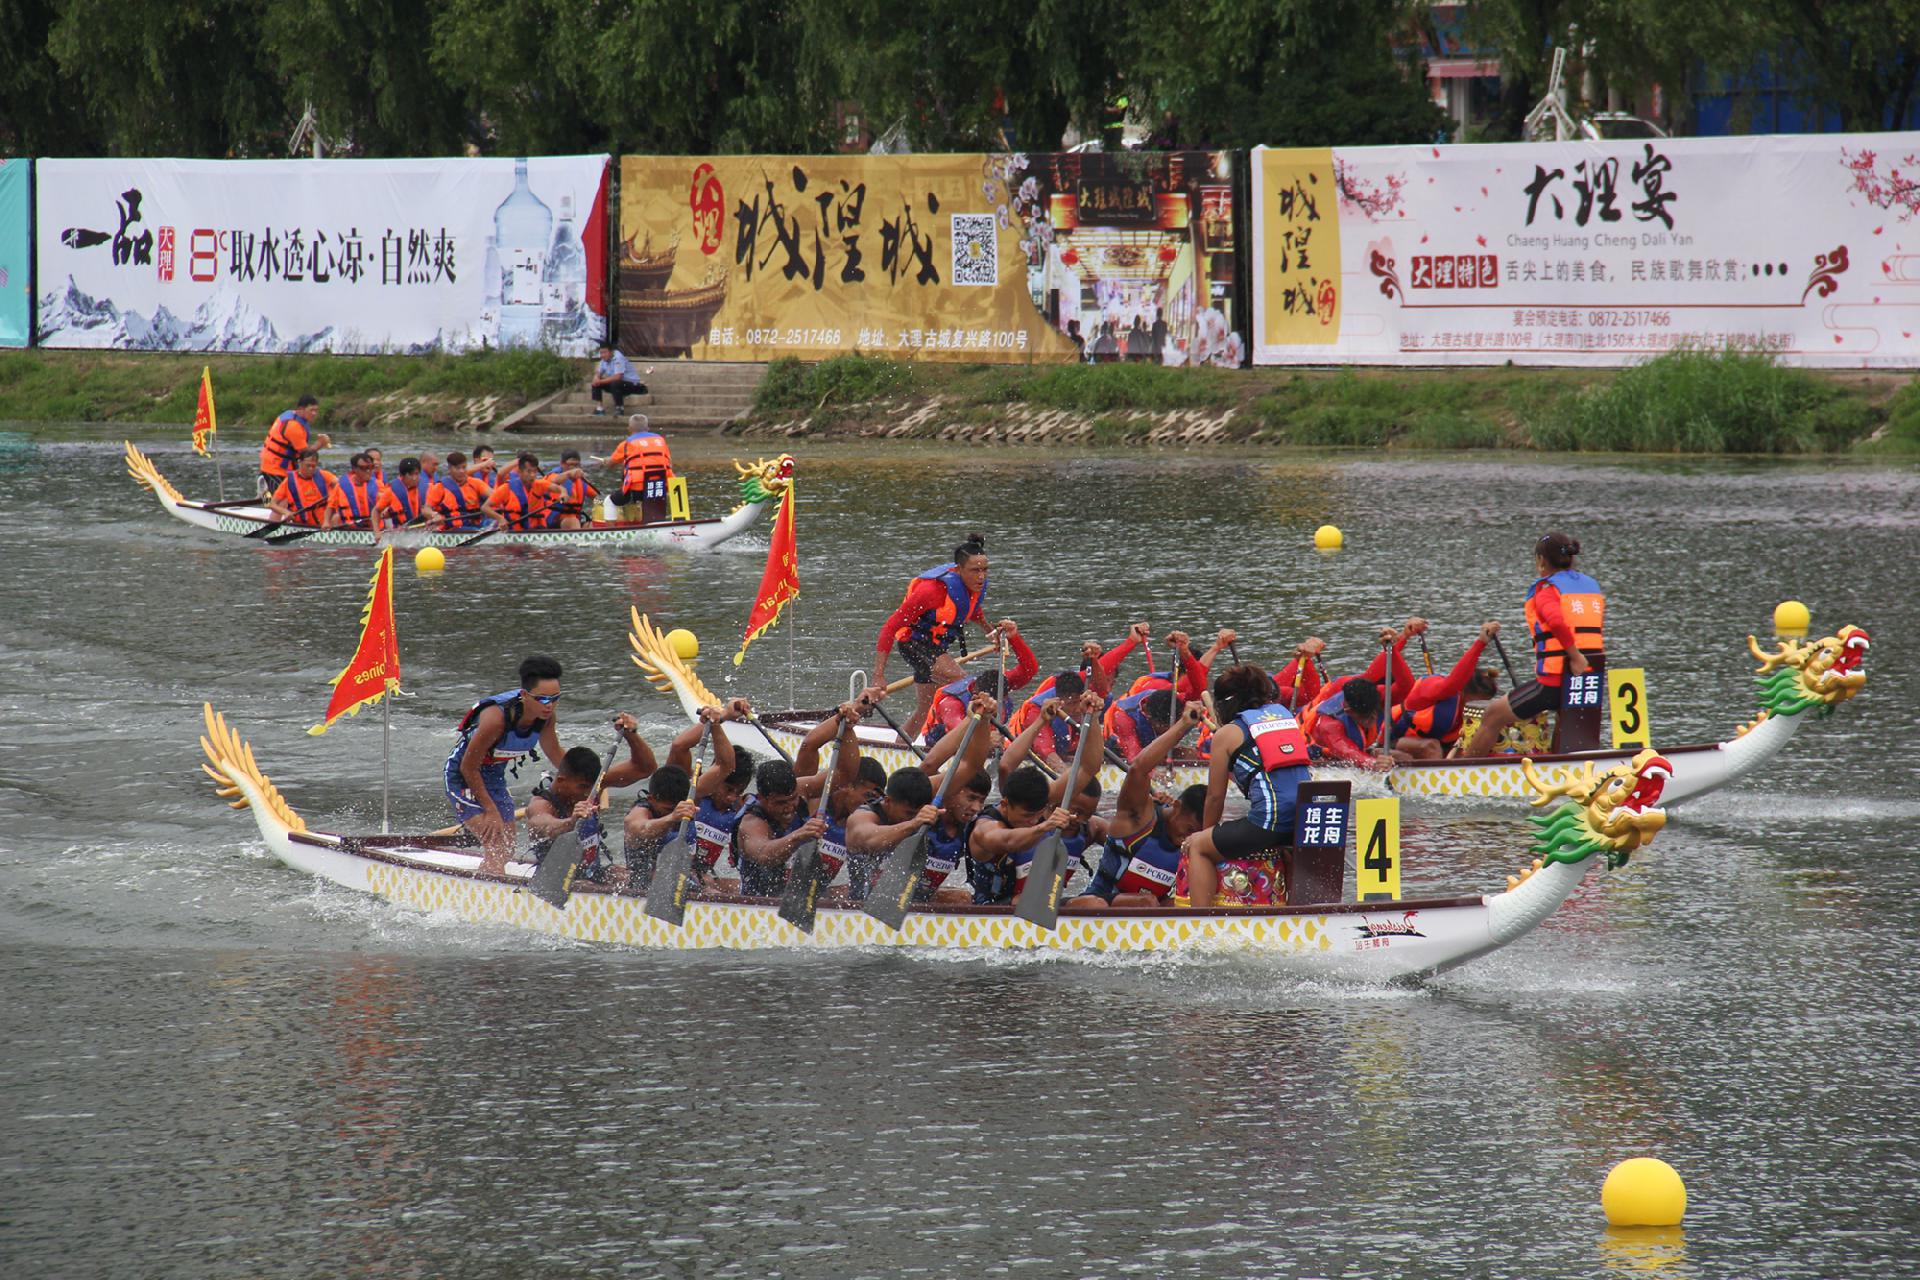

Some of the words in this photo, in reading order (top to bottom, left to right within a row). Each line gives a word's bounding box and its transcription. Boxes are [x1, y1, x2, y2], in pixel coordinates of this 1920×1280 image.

[1523, 143, 1677, 230] 大理宴
[1507, 234, 1549, 250] Chaeng
[1553, 235, 1589, 250] Huang
[1594, 233, 1637, 249] Cheng
[1642, 233, 1667, 246] Dali
[1671, 233, 1693, 246] Yan
[1412, 255, 1497, 288] 大理特色
[673, 485, 683, 513] 1
[1569, 675, 1600, 690] 培生
[1568, 691, 1599, 705] 龙舟
[1618, 682, 1641, 735] 3
[1305, 807, 1343, 824] 培生
[1303, 826, 1341, 844] 龙舟
[1364, 818, 1392, 883] 4
